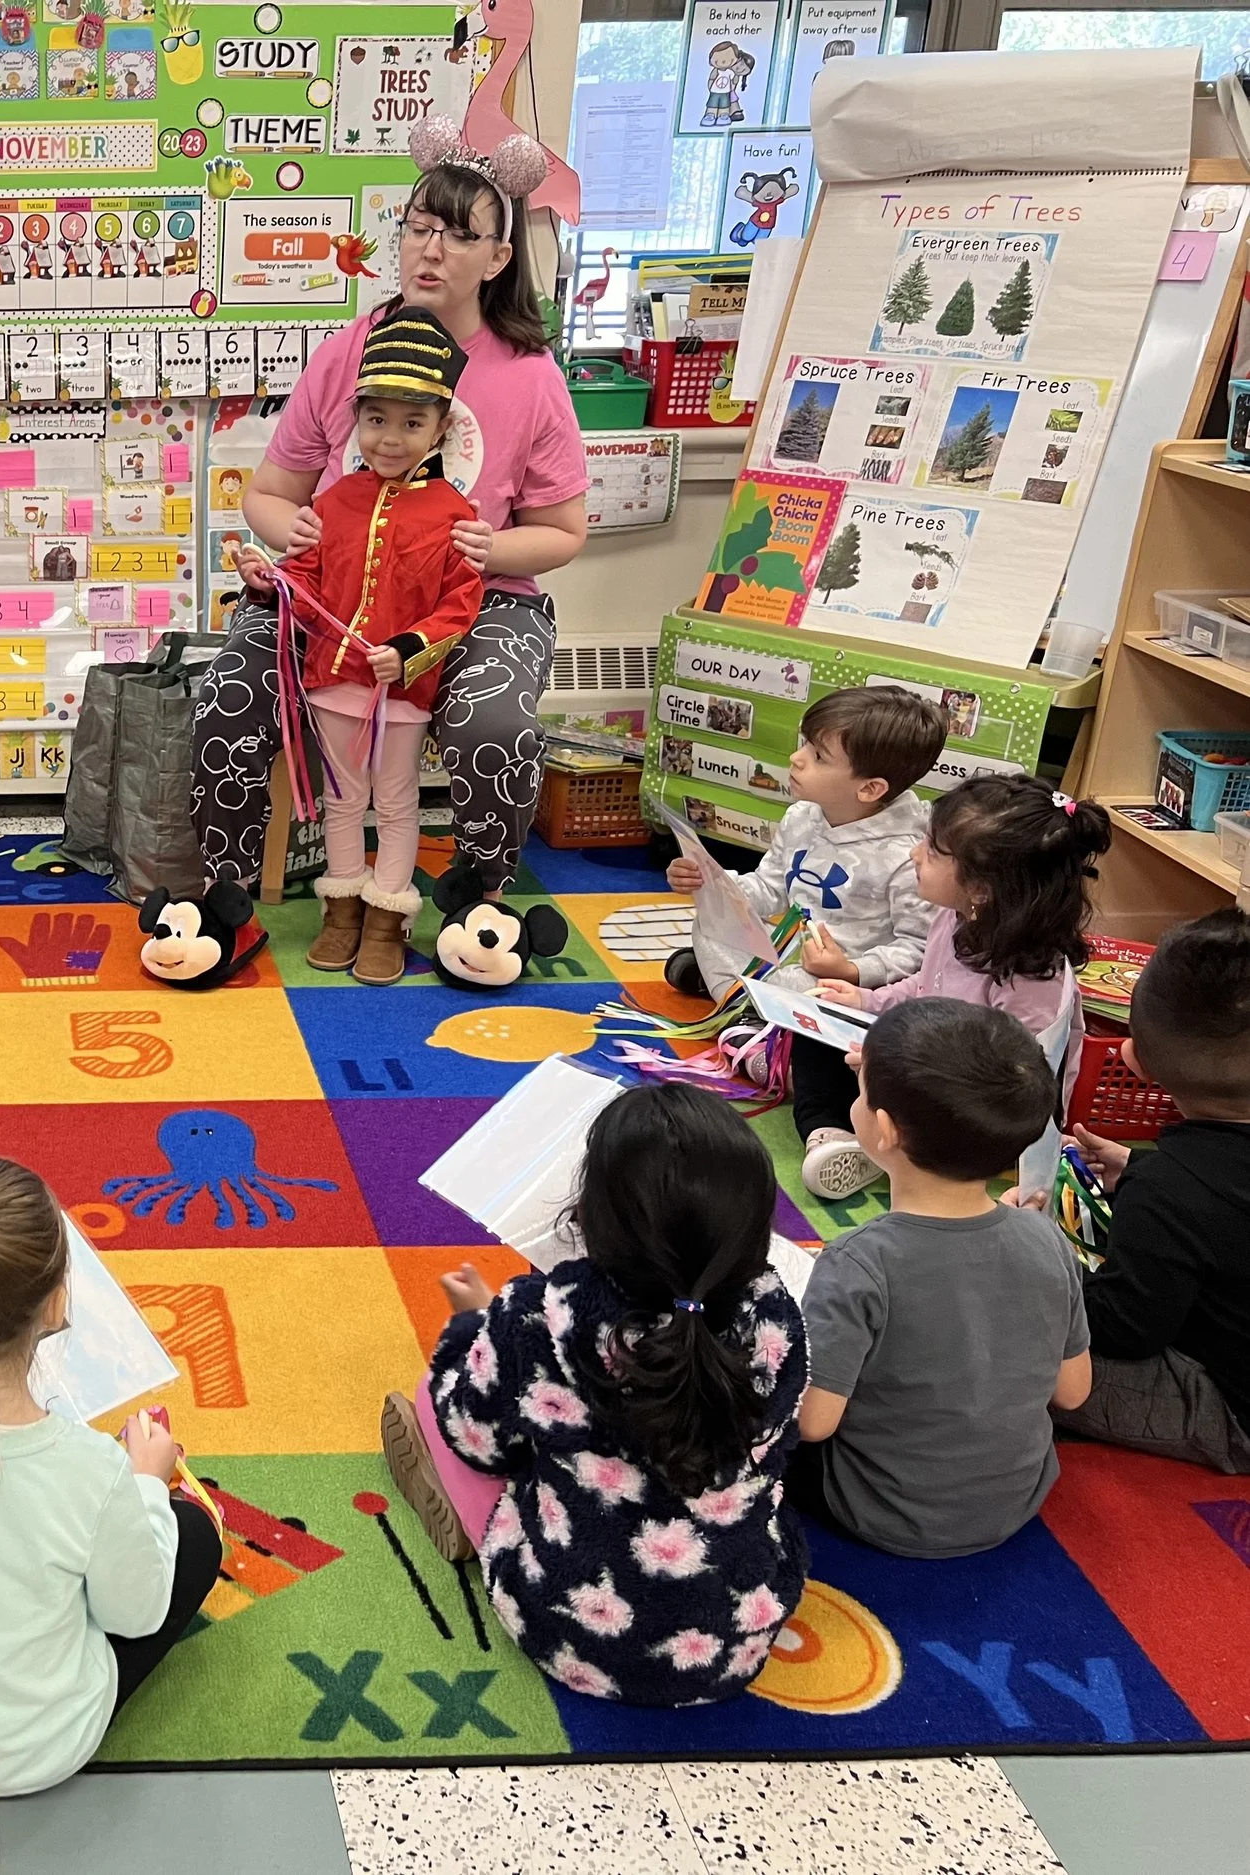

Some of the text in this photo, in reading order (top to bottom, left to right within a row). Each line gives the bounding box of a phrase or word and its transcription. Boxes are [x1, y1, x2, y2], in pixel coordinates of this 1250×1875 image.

[709, 9, 761, 20] Be kind to
[807, 7, 876, 21] Put equipment
[706, 25, 762, 35] each other
[803, 24, 877, 37] away after use
[217, 41, 317, 69] STUDY
[379, 69, 431, 93] TREES
[371, 98, 434, 122] STUDY
[230, 118, 322, 144] THEME
[163, 135, 180, 151] 20
[184, 135, 201, 151] 23
[743, 143, 800, 157] Have fun!
[881, 194, 1082, 227] Types of Trees
[32, 221, 40, 237] 3
[69, 219, 78, 234] 4
[105, 219, 113, 235] 5
[142, 217, 151, 233] 6
[177, 218, 185, 234] 7
[243, 213, 332, 227] The season is
[272, 237, 303, 256] Fall
[912, 236, 1041, 253] Evergreen Trees
[258, 262, 280, 270] Today's
[1172, 244, 1195, 275] 4
[242, 273, 330, 285] sunny and cold
[700, 297, 729, 309] TELL
[26, 331, 287, 358] 2 3 4 5 6 7
[799, 361, 915, 384] Spruce Trees
[25, 385, 42, 393] two
[71, 383, 95, 392] three
[175, 380, 193, 390] five
[227, 381, 238, 389] six
[268, 380, 293, 389] seven
[981, 372, 1071, 394] Fir Trees
[716, 401, 740, 410] Books
[1062, 400, 1080, 410] Leaf
[15, 412, 97, 428] Interest Areas
[1052, 433, 1073, 444] Seeds
[585, 443, 648, 456] NOVEMBER
[1039, 468, 1057, 479] Bark
[776, 493, 823, 509] Chicka
[773, 505, 819, 522] Chicka
[850, 503, 946, 531] Pine Trees
[775, 518, 814, 534] Boom
[772, 530, 811, 546] Boom
[931, 532, 948, 542] Leaf
[111, 551, 168, 573] 2 3 4
[922, 560, 943, 572] Seeds
[910, 591, 926, 601] Bark
[18, 600, 29, 621] 4
[691, 657, 761, 683] OUR DAY
[25, 691, 36, 711] 4
[666, 694, 705, 714] Circle
[670, 708, 700, 728] Time
[9, 748, 25, 768] Jj
[40, 748, 64, 763] Kk
[697, 757, 739, 778] Lunch
[716, 812, 760, 839] Snack
[1091, 939, 1116, 948] The
[70, 1010, 174, 1079] 5
[285, 1649, 519, 1743] Xx
[920, 1638, 1136, 1743] Yy
